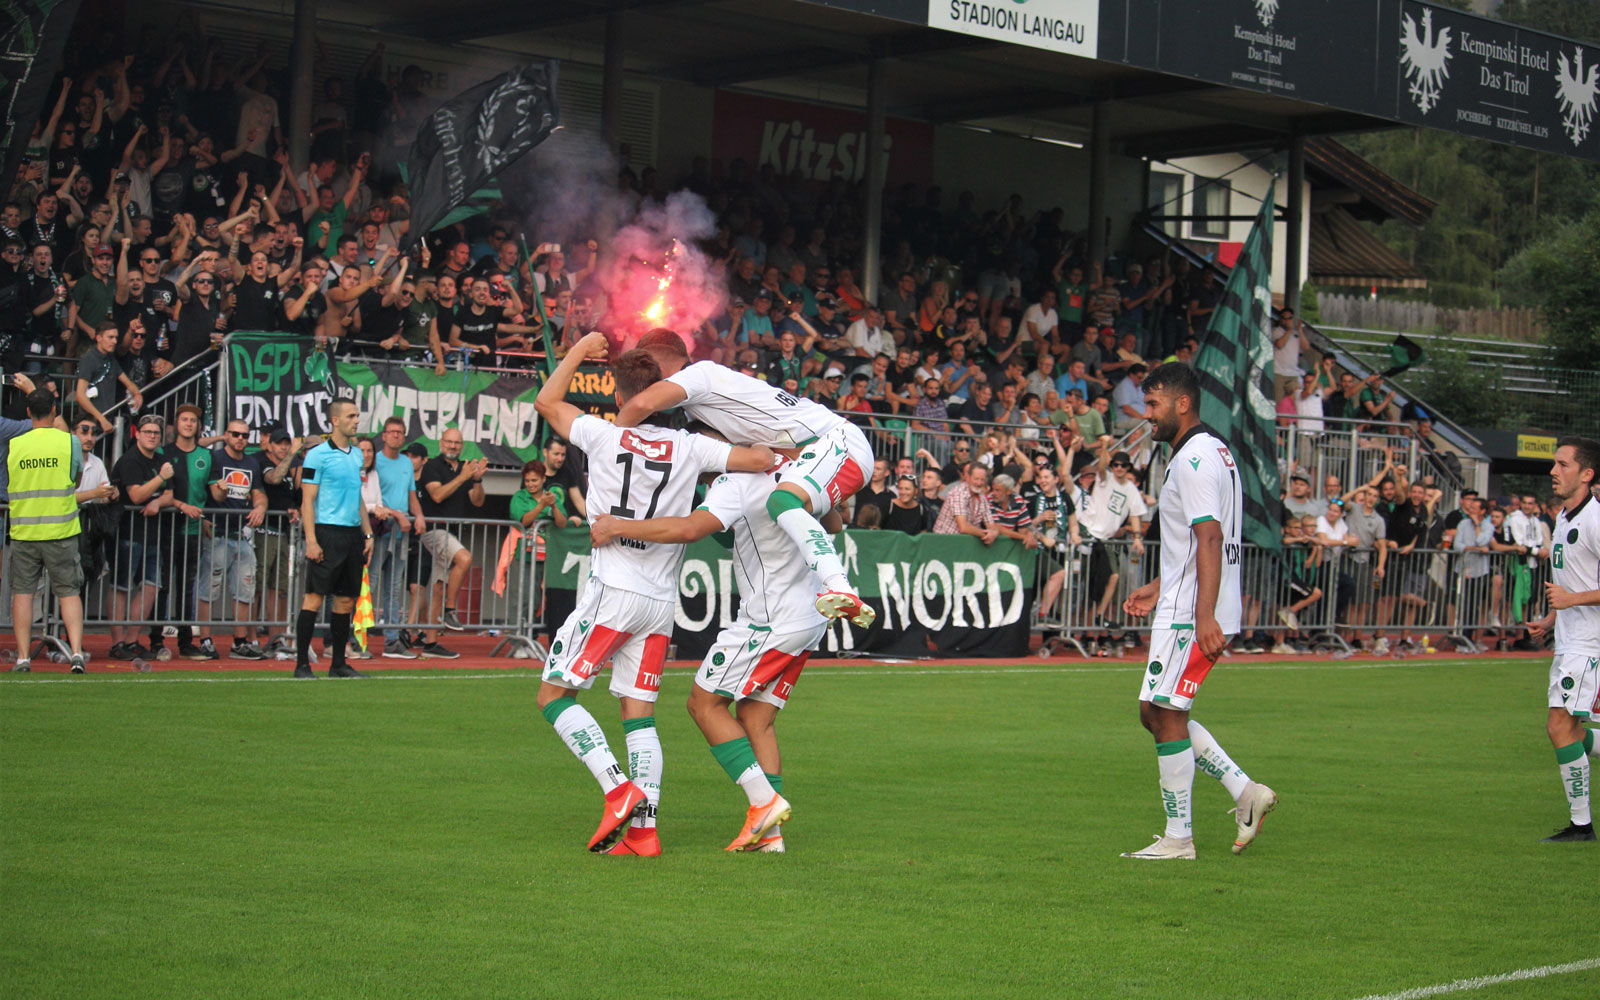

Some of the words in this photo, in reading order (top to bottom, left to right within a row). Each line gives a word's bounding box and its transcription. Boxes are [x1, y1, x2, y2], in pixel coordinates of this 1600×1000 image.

[950, 0, 1018, 31] STADION
[1022, 13, 1085, 45] LANGAU
[1234, 25, 1273, 45] Kempinski
[1274, 34, 1296, 51] Hotel
[1248, 46, 1262, 61] Das
[1263, 49, 1282, 65] Tirol
[1461, 31, 1517, 63] Kempinski
[1520, 46, 1550, 71] Hotel
[1480, 66, 1501, 89] Das
[1503, 71, 1530, 96] Tirol
[1533, 126, 1549, 138] ALPS
[355, 384, 538, 449] UNTERLAND
[19, 457, 58, 470] ORDNER
[610, 453, 672, 520] 17
[877, 559, 1024, 632] NORD
